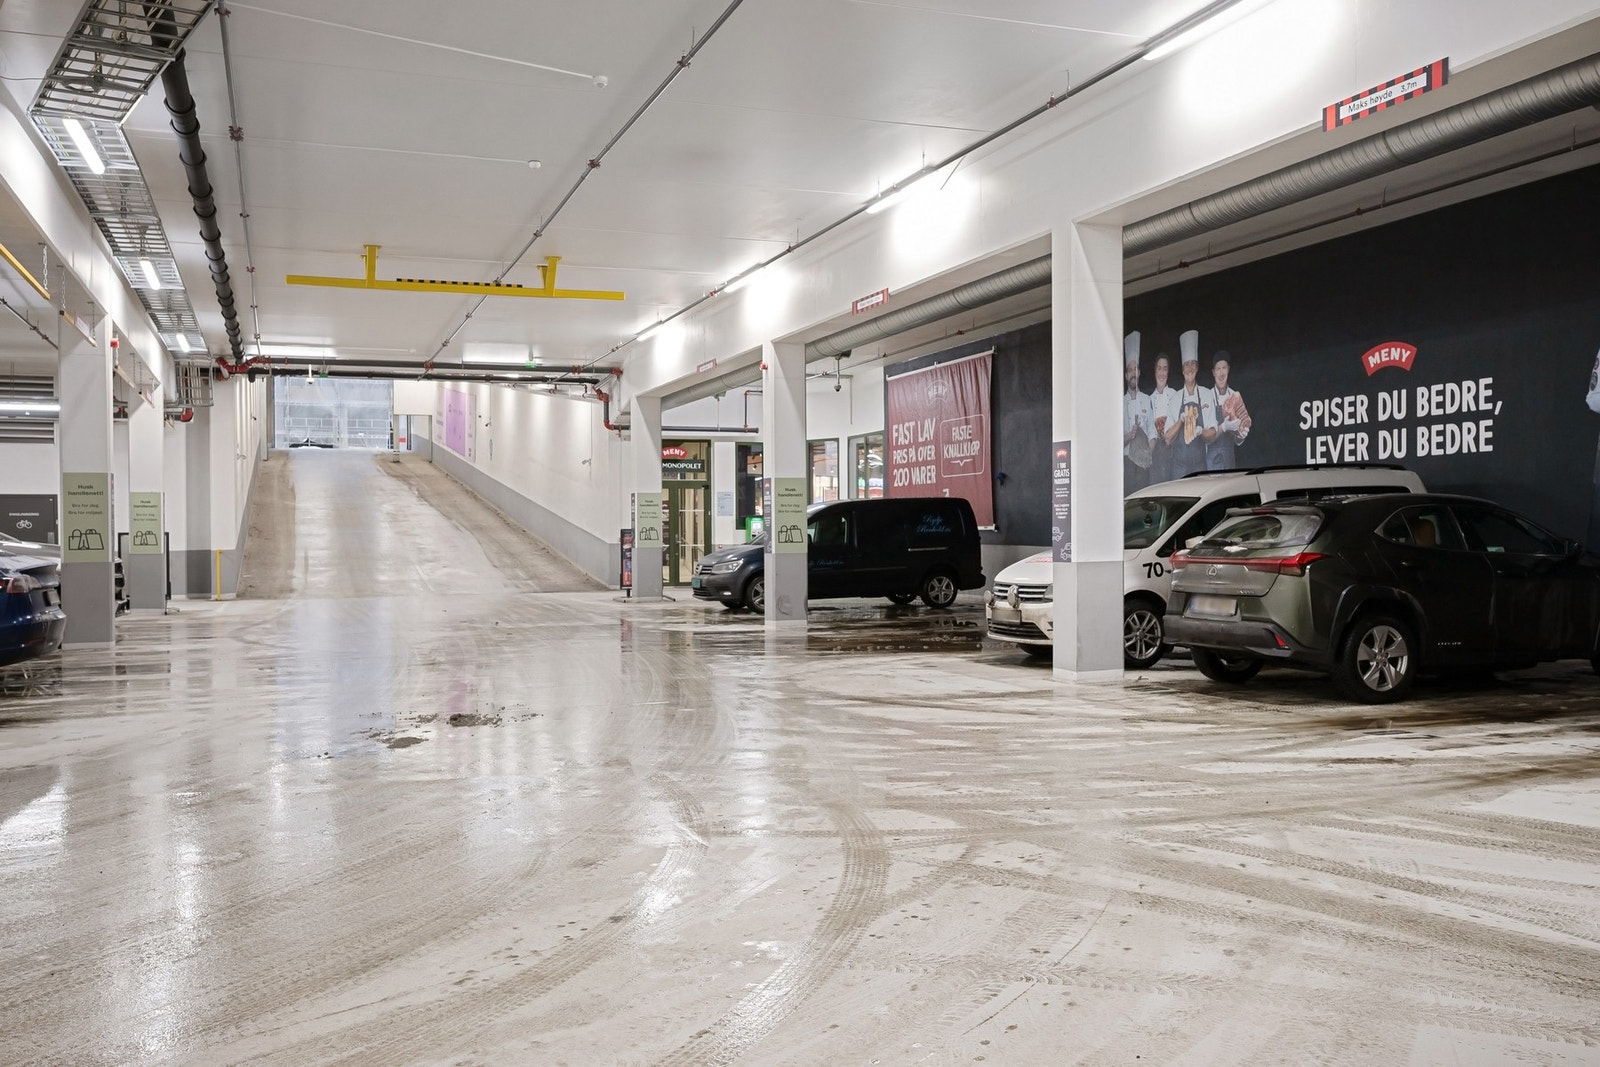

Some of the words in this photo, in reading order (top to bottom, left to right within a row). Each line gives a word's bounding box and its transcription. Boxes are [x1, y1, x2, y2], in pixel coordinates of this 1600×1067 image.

[1348, 100, 1368, 113] Maks
[1369, 90, 1393, 105] høyde
[1368, 347, 1411, 368] MENY
[927, 385, 948, 399] MENY
[1299, 394, 1369, 430] SPISER
[1378, 389, 1407, 422] DU
[1416, 377, 1503, 418] BEDRE,
[892, 421, 915, 446] FAST
[918, 417, 936, 442] LAV
[952, 425, 972, 442] FASTE
[943, 440, 980, 459] KNALLKJØP
[1306, 432, 1369, 465] LEVER
[1378, 428, 1407, 460] DU
[1416, 419, 1493, 457] BEDRE
[662, 448, 685, 457] MENY
[893, 449, 908, 464] PRIS
[908, 445, 916, 462] PÅ
[917, 445, 936, 462] OVER
[893, 467, 909, 487] 200
[911, 465, 936, 485] VARER
[1054, 469, 1070, 478] GRATIS
[1142, 562, 1164, 578] 70
